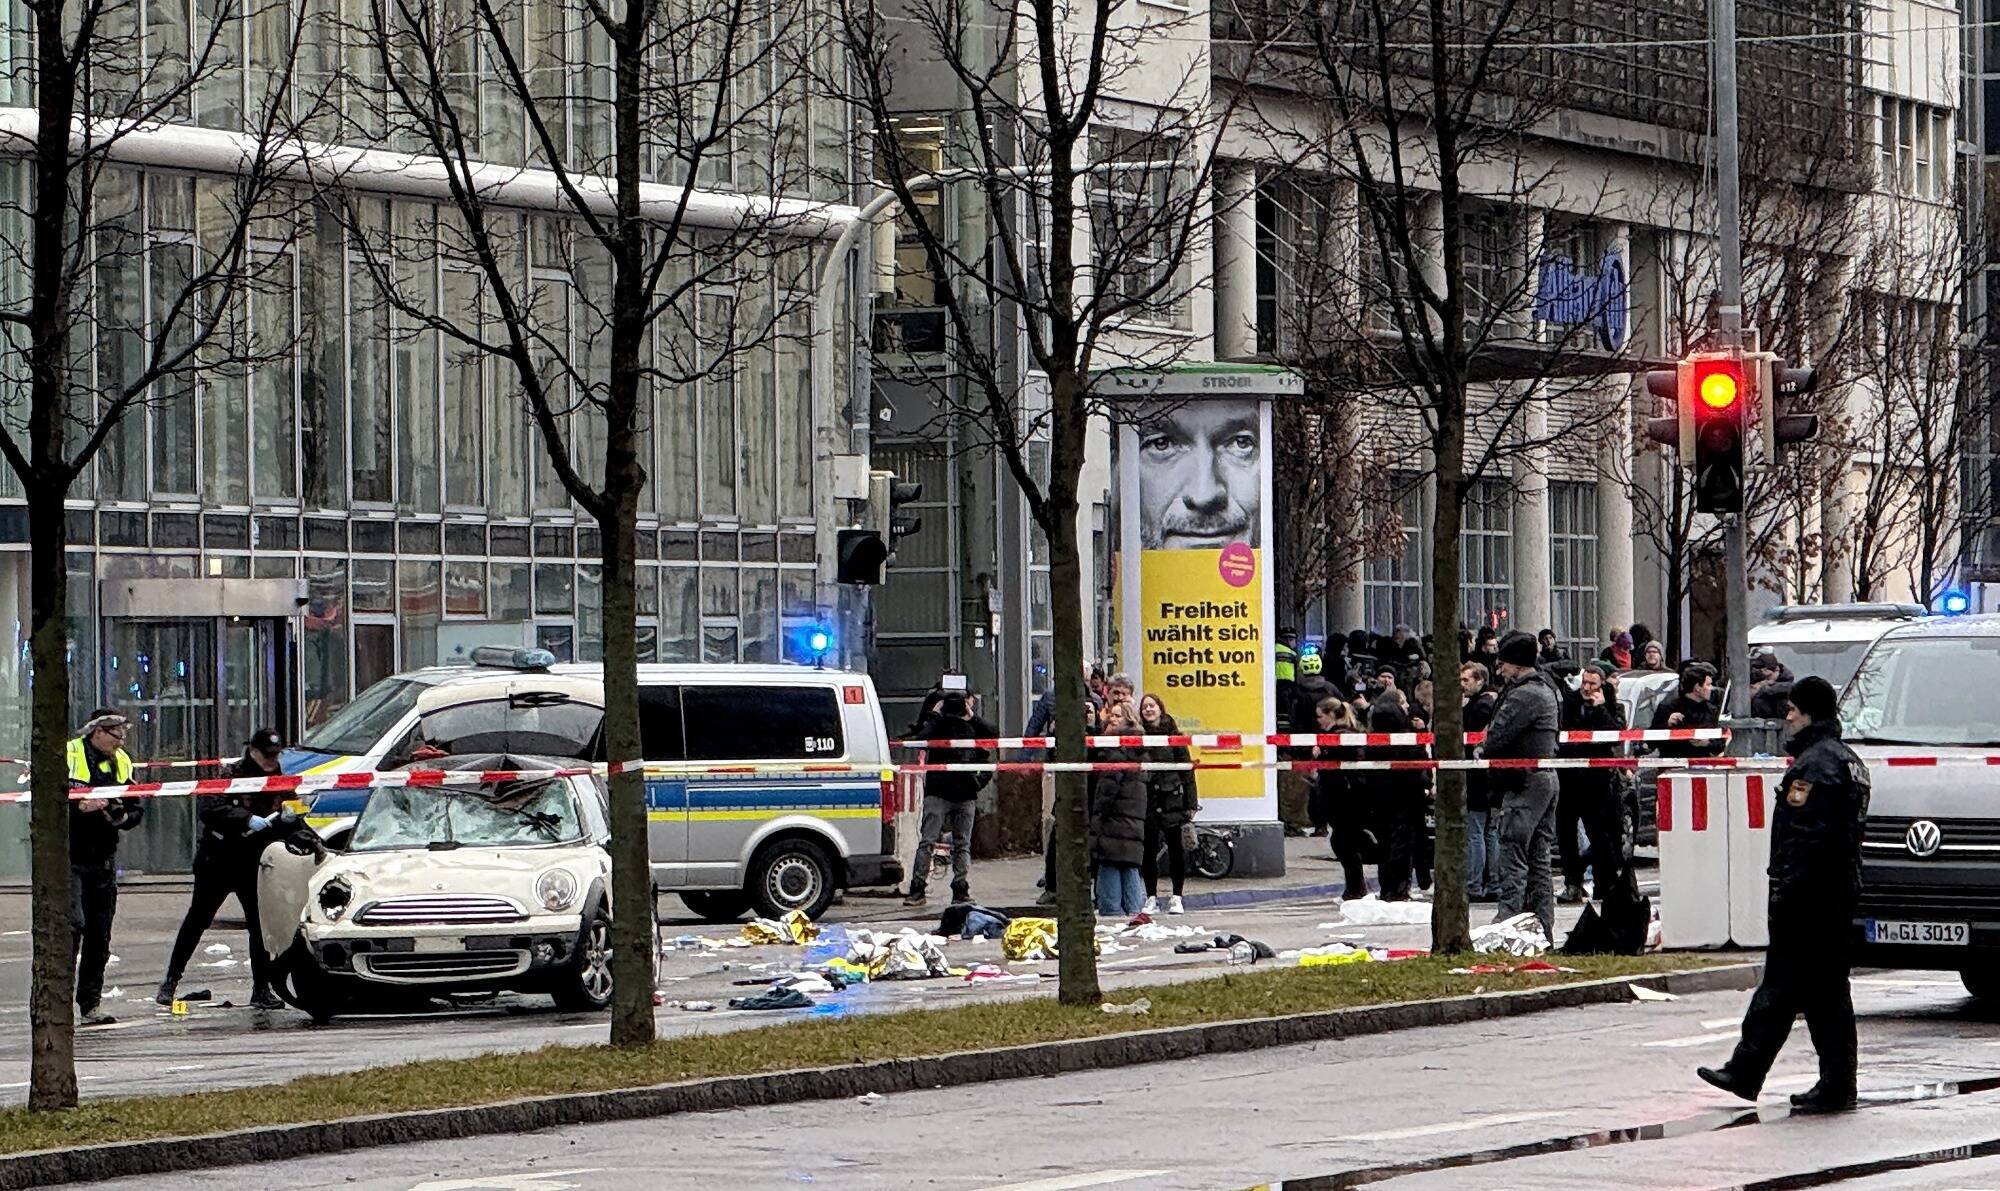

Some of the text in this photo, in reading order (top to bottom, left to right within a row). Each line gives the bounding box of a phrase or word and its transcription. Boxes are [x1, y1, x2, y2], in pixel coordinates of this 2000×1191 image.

[1160, 601, 1248, 619] Freiheit
[1147, 624, 1259, 641] wählt sich
[1153, 647, 1255, 664] nicht von
[1166, 669, 1246, 687] selbst.
[816, 737, 835, 751] 110
[1877, 923, 1889, 940] M
